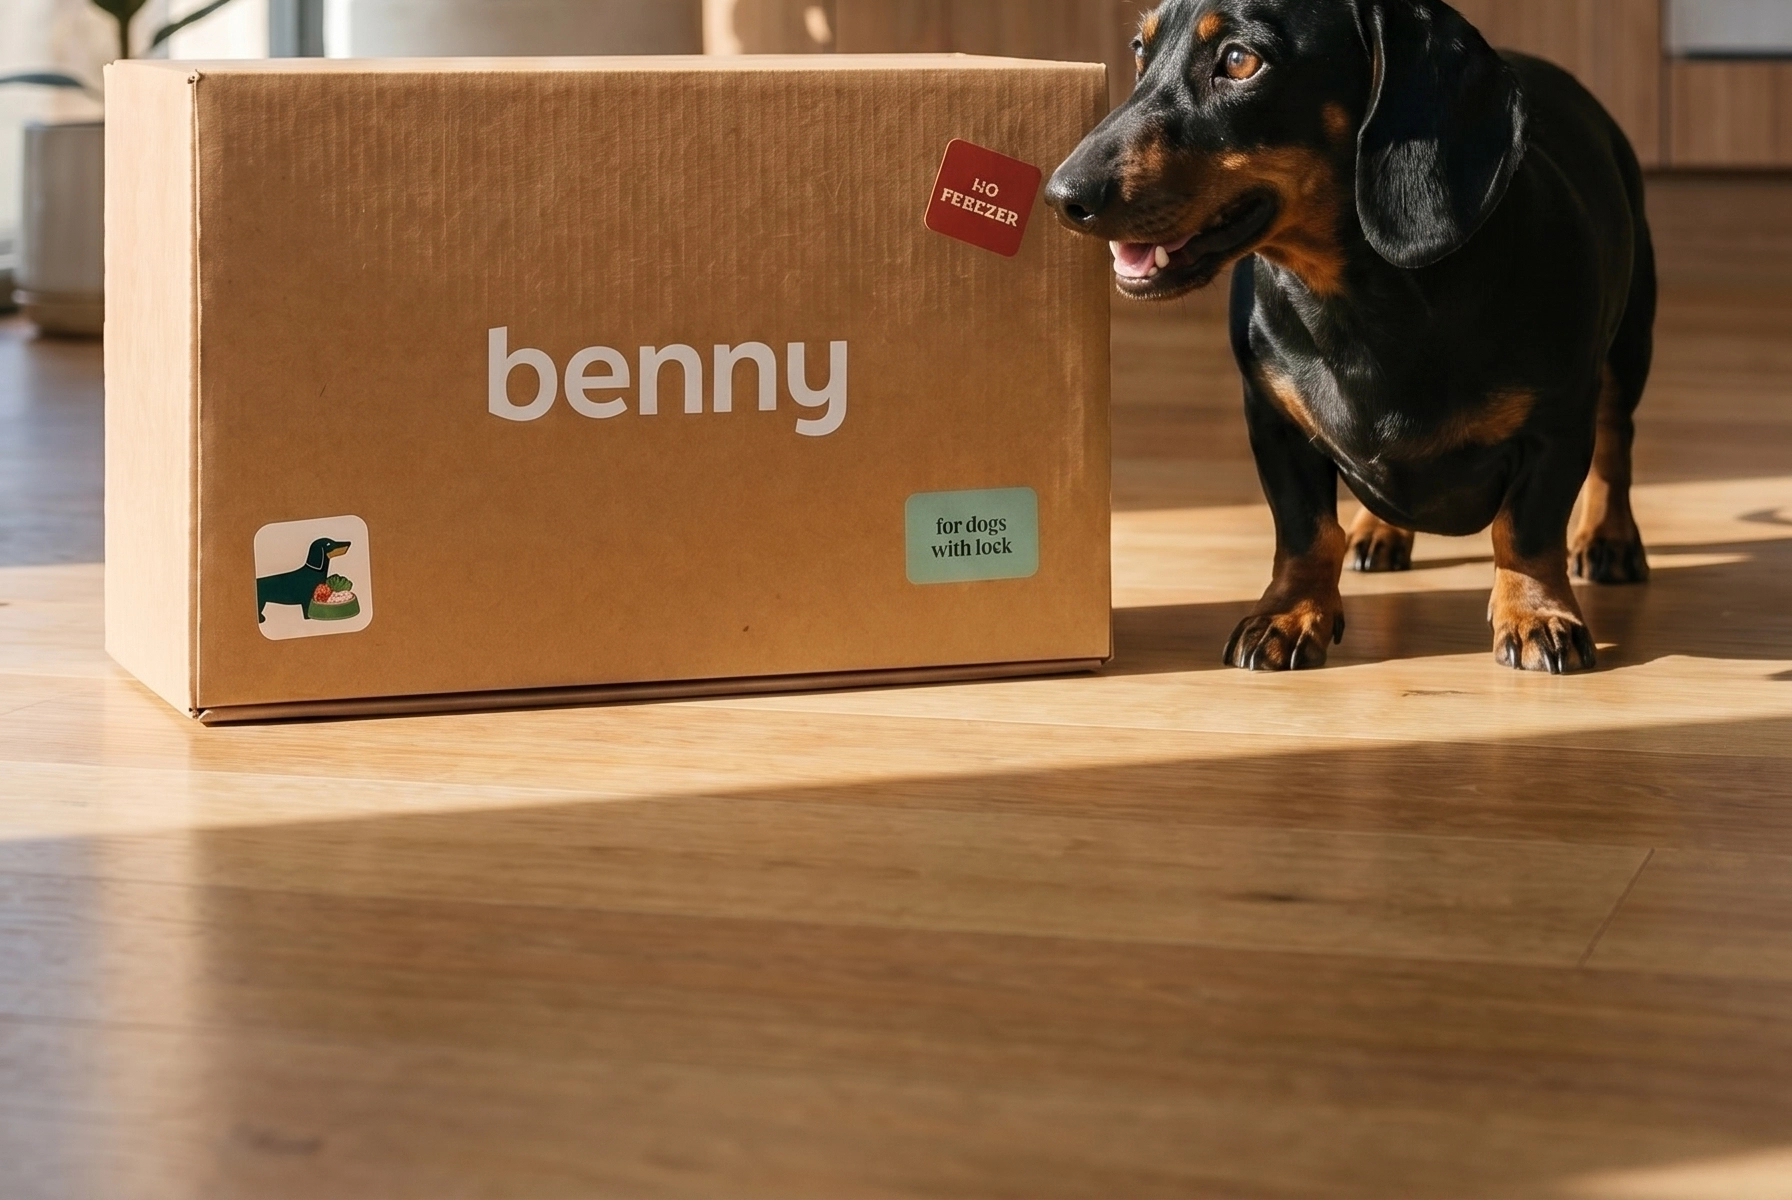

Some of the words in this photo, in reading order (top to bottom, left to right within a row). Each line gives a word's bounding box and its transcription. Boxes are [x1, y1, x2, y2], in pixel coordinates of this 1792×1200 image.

[488, 326, 848, 437] benny
[936, 517, 963, 535] for
[965, 515, 1007, 536] dogs
[931, 539, 972, 558] with
